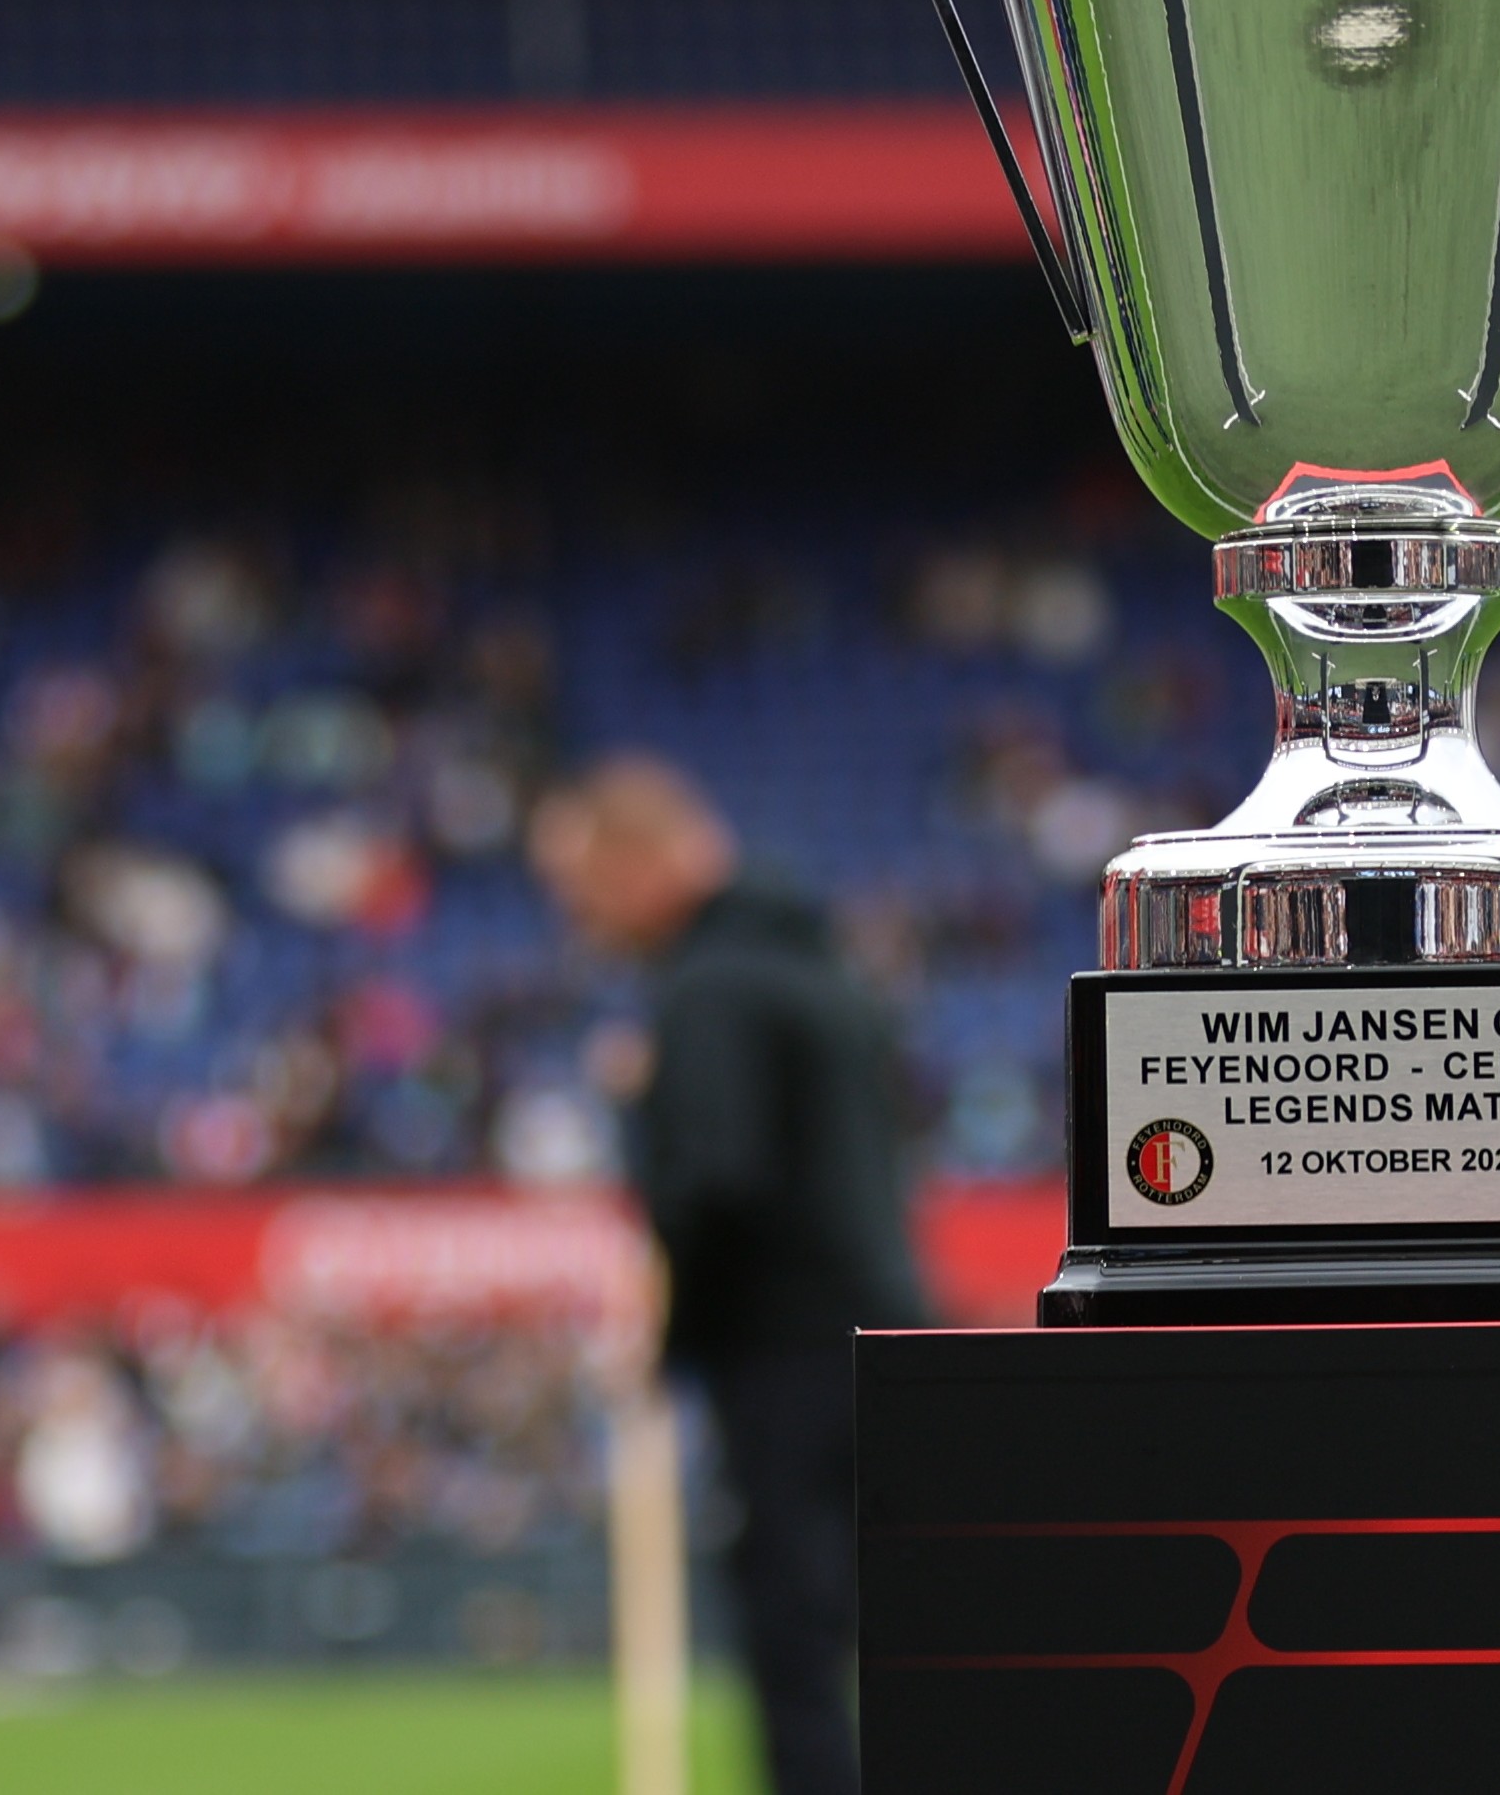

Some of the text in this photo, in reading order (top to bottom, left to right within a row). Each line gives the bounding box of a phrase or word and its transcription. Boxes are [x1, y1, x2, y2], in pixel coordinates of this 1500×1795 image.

[1201, 1011, 1290, 1044] WIM
[1302, 1007, 1479, 1043] JANSEN
[1141, 1052, 1389, 1085] FEYENOORD
[1224, 1093, 1413, 1125] LEGENDS
[1132, 1121, 1207, 1151] FEYENOORD
[1260, 1151, 1293, 1175] 12
[1301, 1148, 1452, 1175] OKTOBER
[1133, 1173, 1208, 1203] ROTTERDAM
